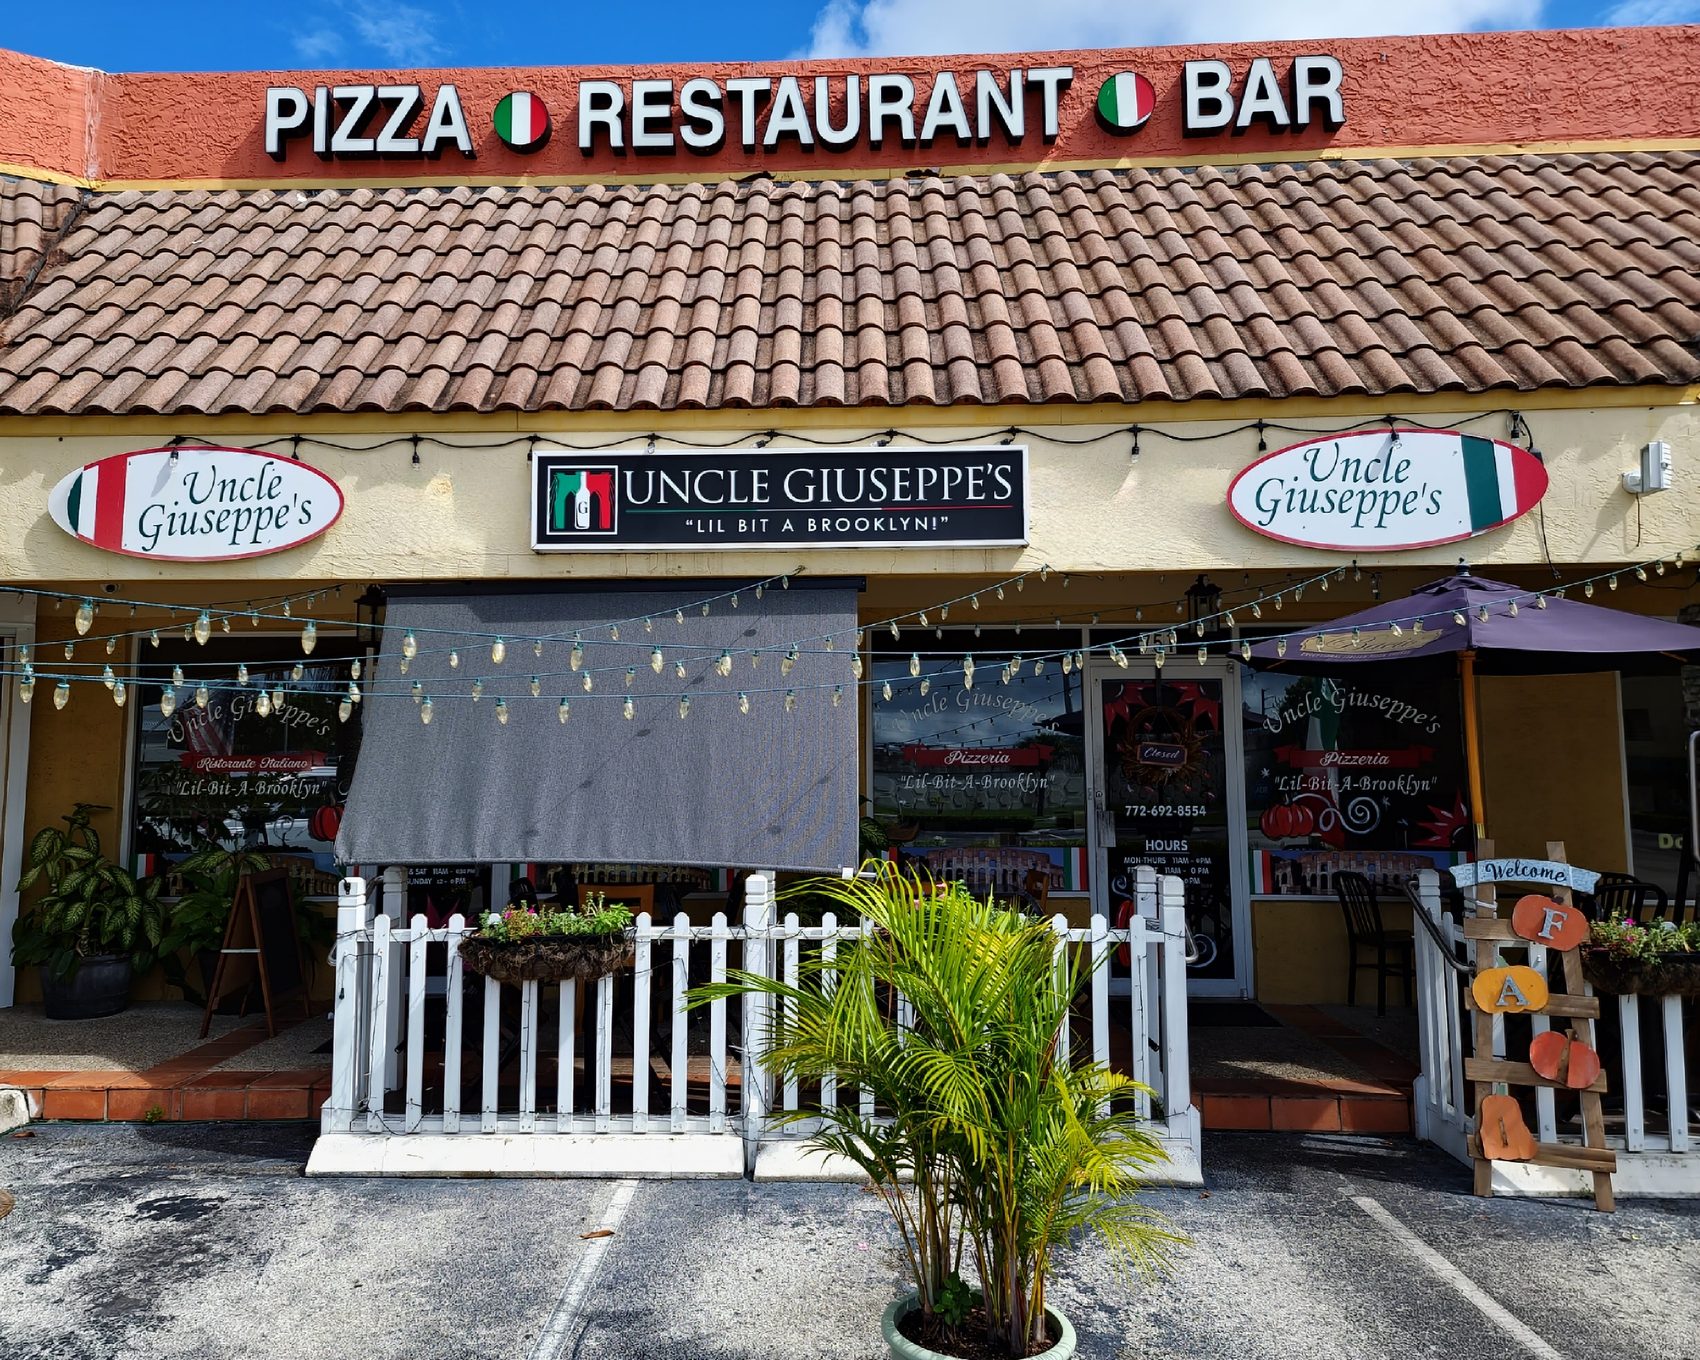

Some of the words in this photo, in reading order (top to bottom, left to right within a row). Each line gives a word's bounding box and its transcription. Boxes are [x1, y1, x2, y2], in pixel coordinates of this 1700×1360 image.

[265, 84, 472, 154] PIZZA
[578, 67, 1074, 150] RESTAURANT
[1184, 55, 1346, 130] BAR
[1303, 442, 1411, 484] Uncle
[183, 460, 283, 505] Uncle
[623, 468, 770, 505] UNCLE
[783, 463, 1013, 503] GIUSEPPE'S
[578, 501, 588, 515] G
[1254, 475, 1442, 529] Giuseppe's
[138, 493, 312, 552] Giuseppe's
[738, 518, 769, 533] BIT
[781, 518, 795, 533] A
[167, 702, 223, 742] Uncle
[230, 694, 331, 736] Giseppe's
[955, 687, 1060, 733] Giuseppes
[1262, 690, 1322, 734] Uncle
[1330, 686, 1441, 735] Giuseppe's
[196, 757, 256, 772] Ristorante
[259, 757, 308, 770] Italiano
[943, 750, 1011, 766] Pizzeria
[1143, 746, 1181, 759] Closed
[1319, 751, 1390, 767] Pizzeria
[1125, 804, 1207, 817] 772-692-8554
[1145, 838, 1189, 851] HOURS
[1485, 859, 1568, 883] Welcome
[1537, 906, 1568, 941] F
[1495, 974, 1530, 1007] A
